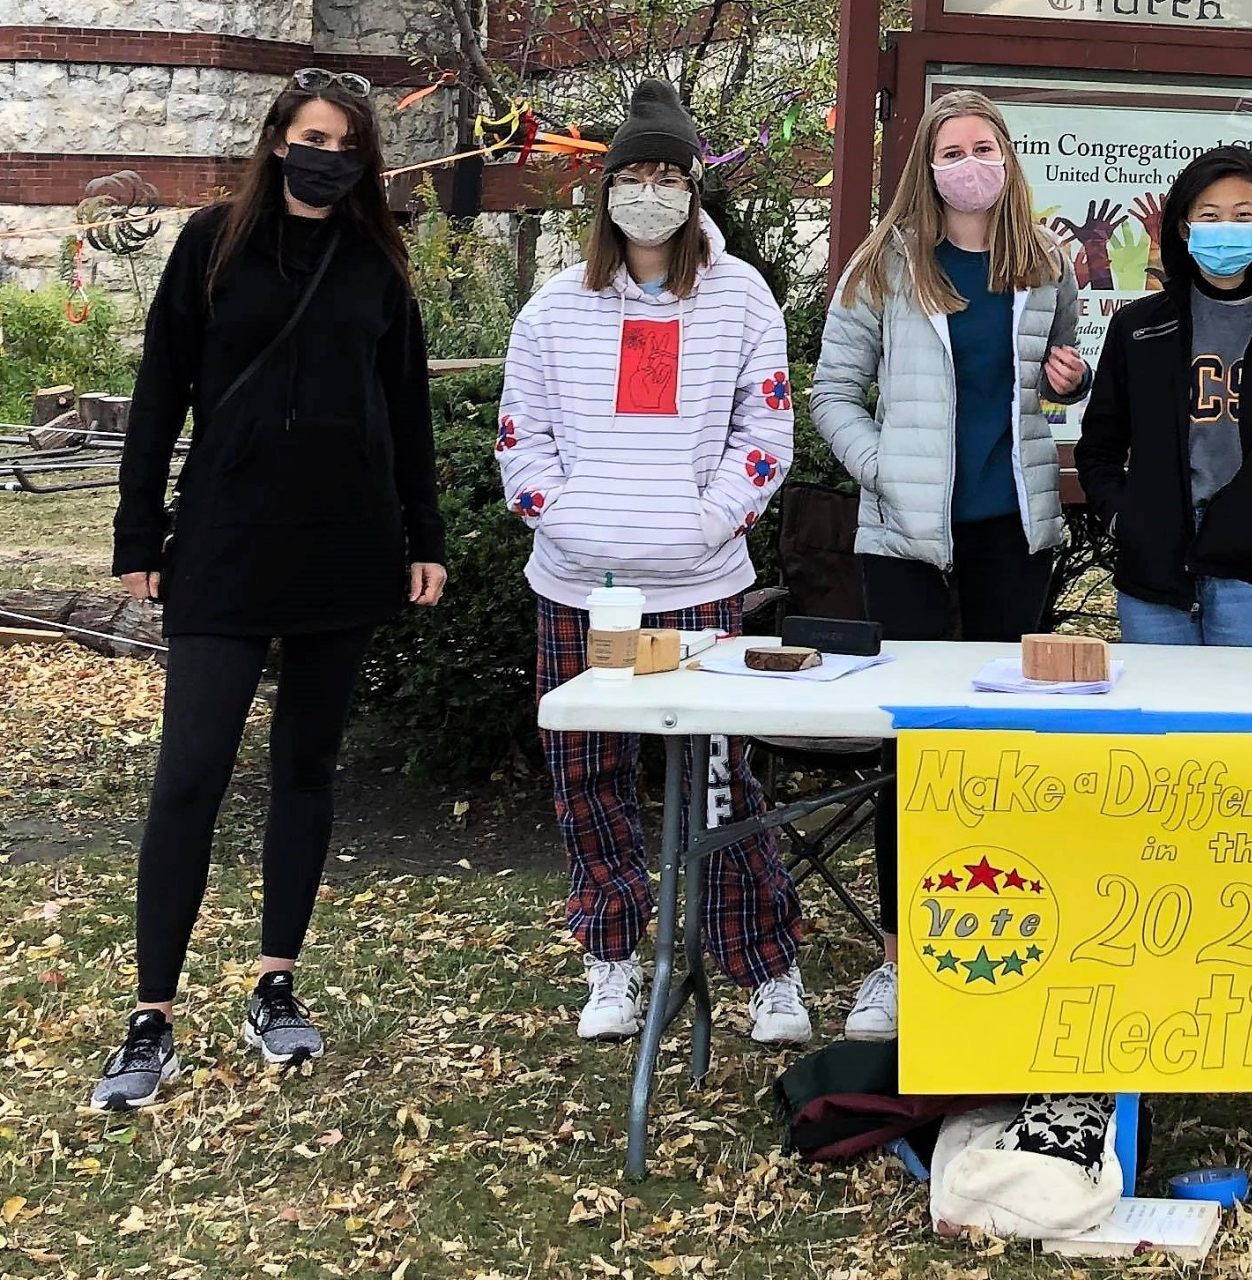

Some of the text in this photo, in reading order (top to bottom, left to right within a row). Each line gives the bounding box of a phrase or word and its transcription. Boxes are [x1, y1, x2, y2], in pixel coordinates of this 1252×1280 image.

[1013, 134, 1050, 155] rim
[1046, 165, 1099, 183] United
[1104, 165, 1161, 185] Church
[904, 749, 1066, 828] Make
[1073, 771, 1098, 795] a
[1141, 836, 1178, 862] in
[920, 898, 1042, 938] Vote
